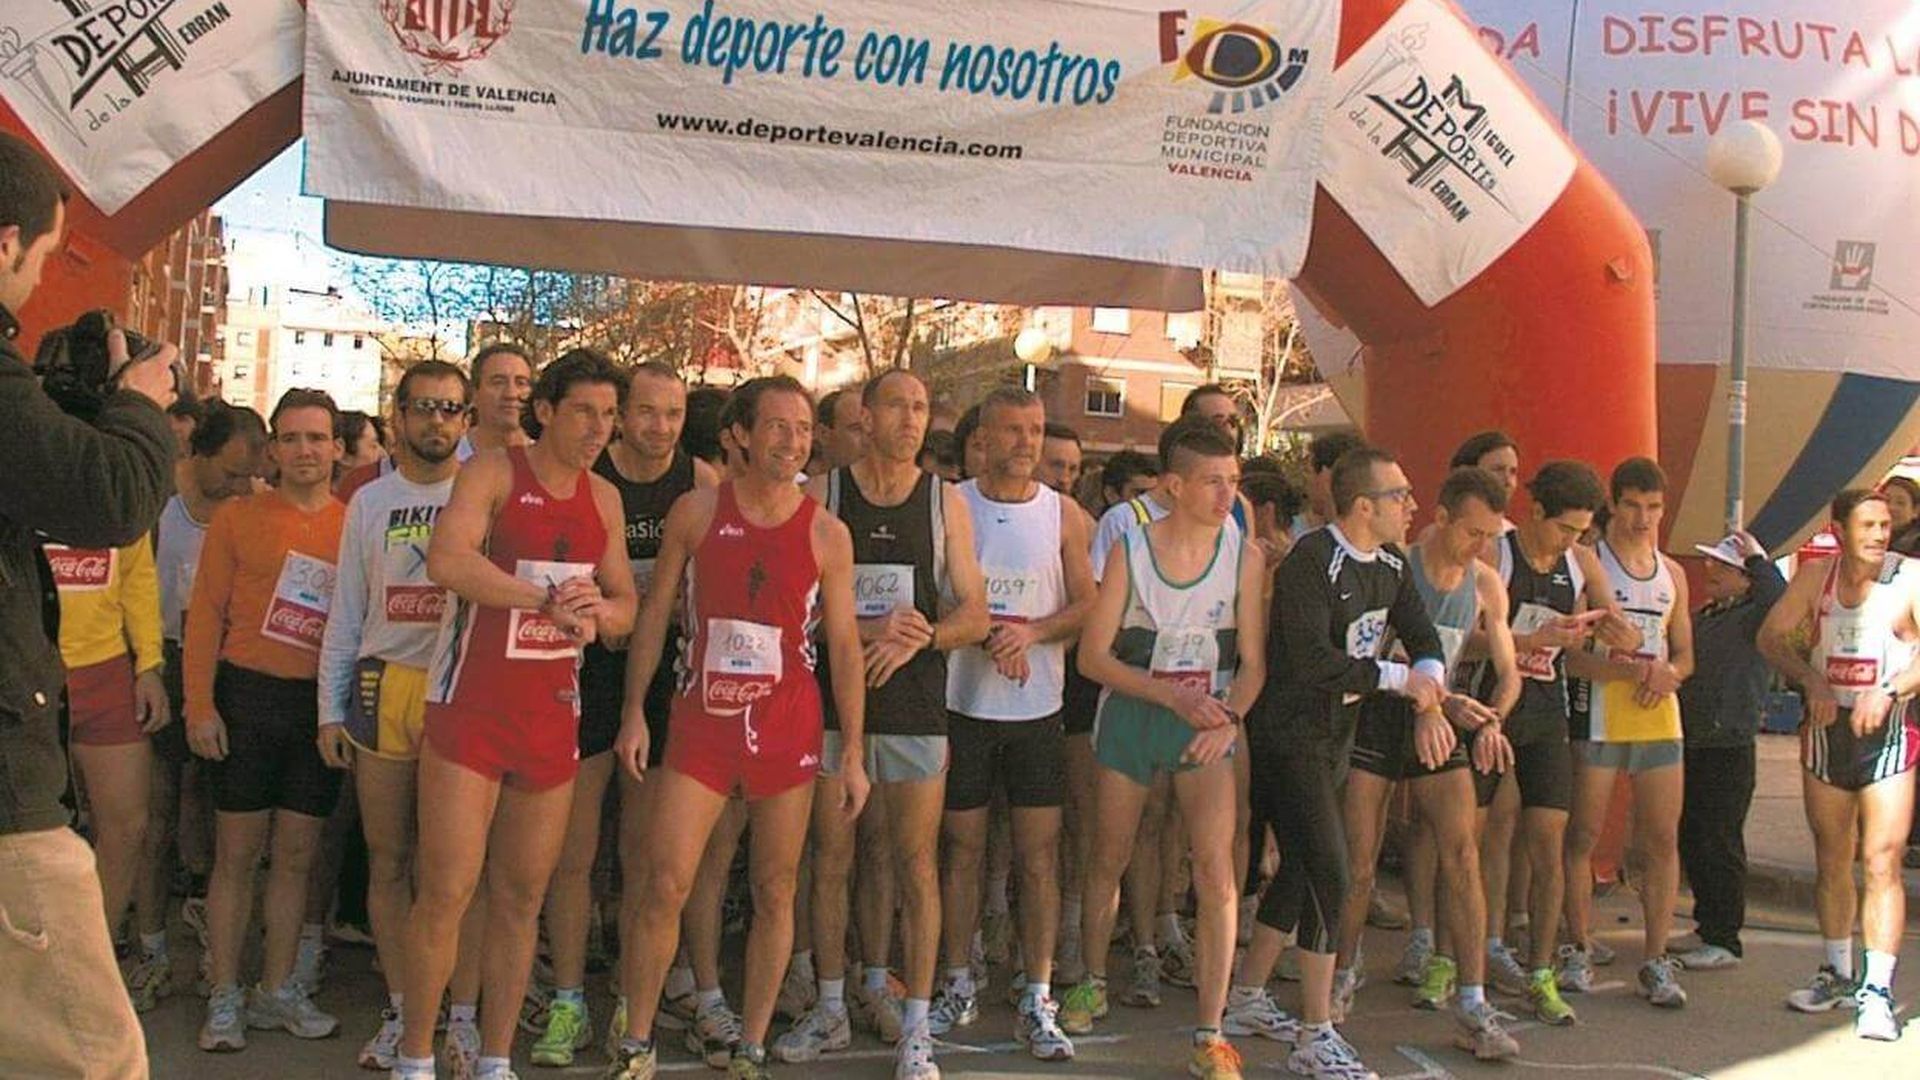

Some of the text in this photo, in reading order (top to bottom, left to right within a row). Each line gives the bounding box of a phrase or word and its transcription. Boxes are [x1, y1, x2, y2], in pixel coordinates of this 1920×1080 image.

[52, 0, 167, 77] DEPO
[582, 0, 1120, 105] Haz deporte con nosotros
[1603, 15, 1871, 68] DISFRUTA
[1886, 35, 1920, 77] L
[332, 69, 557, 105] AJUNTAMENT DE VALENCIA
[657, 112, 1023, 158] www.deportevalencia.com
[1162, 131, 1268, 153] DEPORTIVA
[1165, 116, 1271, 138] FUNDACION
[1395, 75, 1498, 190] DEPORTES
[1790, 98, 1879, 148] SIN
[1161, 146, 1267, 168] MUNICIPAL
[1168, 163, 1253, 181] VALENCIA
